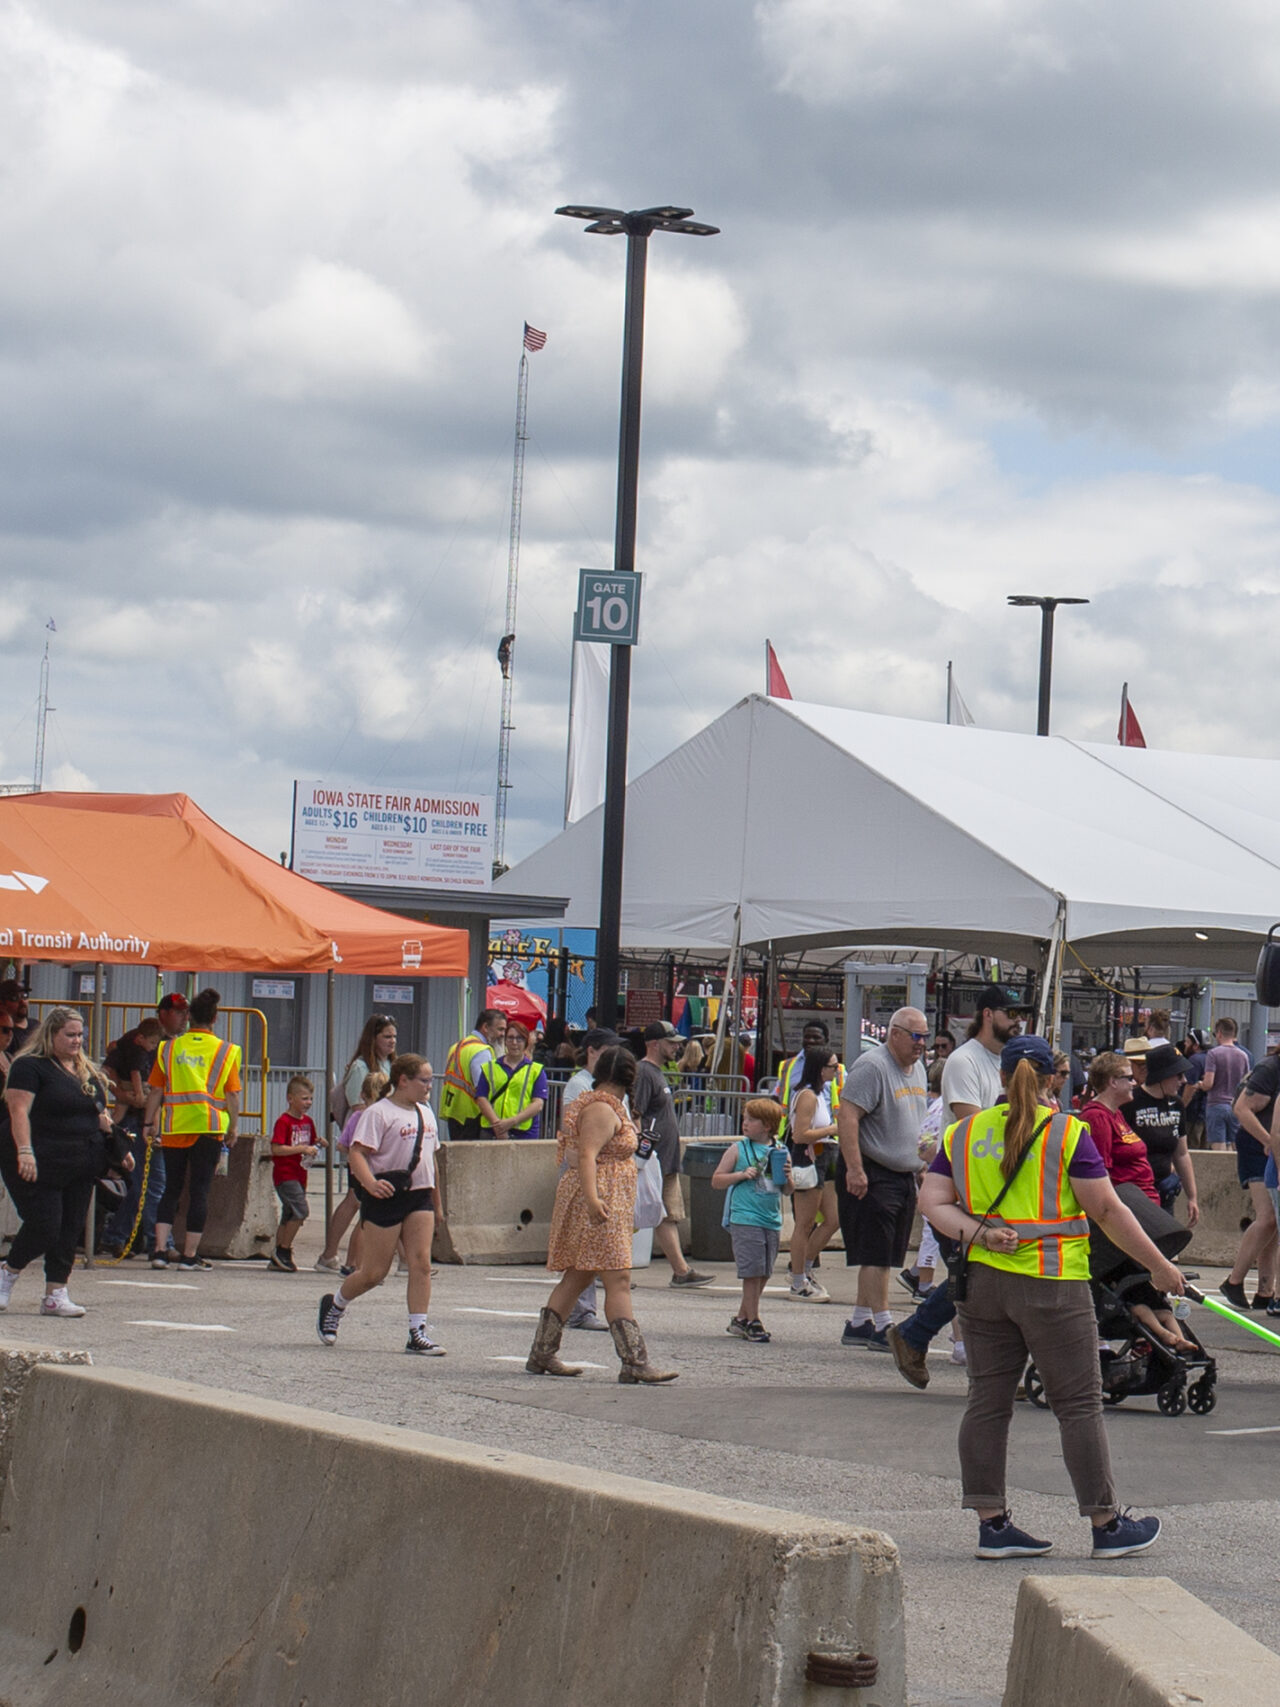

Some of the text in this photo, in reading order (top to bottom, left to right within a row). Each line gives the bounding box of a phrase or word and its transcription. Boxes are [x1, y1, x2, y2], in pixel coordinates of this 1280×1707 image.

[593, 582, 626, 594] GATE
[586, 596, 629, 631] 10
[313, 789, 479, 817] IOWA STATE FAIR ADMISSION
[302, 806, 358, 829] ADULTS $16
[363, 811, 403, 824] CHILDREN
[403, 815, 427, 834] $10
[431, 819, 463, 829] CHILDREN
[464, 823, 488, 837] FREE
[17, 928, 72, 949] Transit
[77, 931, 149, 959] Authority
